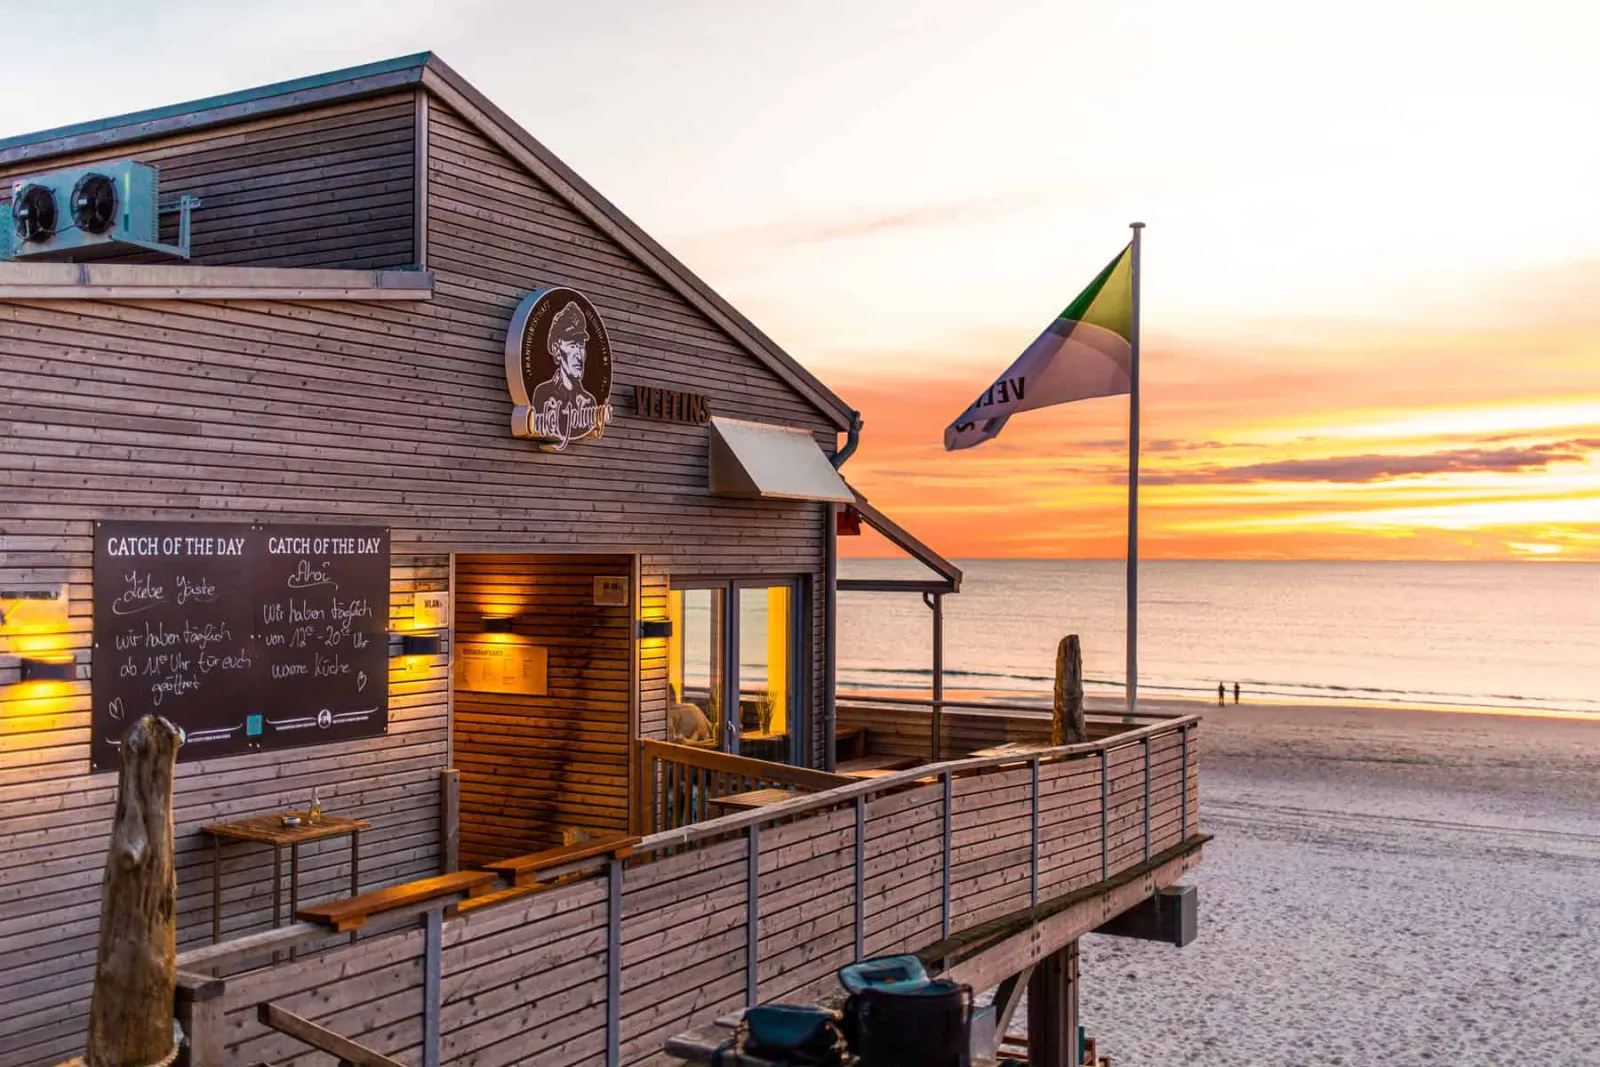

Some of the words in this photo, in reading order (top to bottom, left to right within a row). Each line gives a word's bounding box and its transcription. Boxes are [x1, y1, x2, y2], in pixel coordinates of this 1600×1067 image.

[634, 385, 711, 424] VELTINS
[108, 537, 159, 555] CATCH
[163, 537, 182, 555] OF
[186, 538, 213, 555] THE
[217, 538, 245, 555] DAY
[268, 537, 311, 554] CATCH
[313, 538, 330, 554] OF
[331, 538, 355, 554] THE
[358, 538, 381, 554] DAY
[296, 560, 331, 582] Ahoi
[123, 570, 164, 603] Liebe
[263, 604, 285, 624] Wir
[289, 598, 325, 624] haben
[331, 597, 373, 629] täglich
[116, 629, 143, 650] wir
[145, 620, 180, 648] haben
[183, 620, 232, 649] täglich
[266, 634, 285, 646] von
[353, 632, 370, 648] Uhr
[120, 656, 137, 677] ab
[170, 652, 191, 672] Uhr
[198, 652, 219, 673] für
[221, 648, 251, 669] euch
[271, 664, 307, 678] warme
[315, 652, 352, 676] Küche
[152, 674, 201, 706] geöffnet
